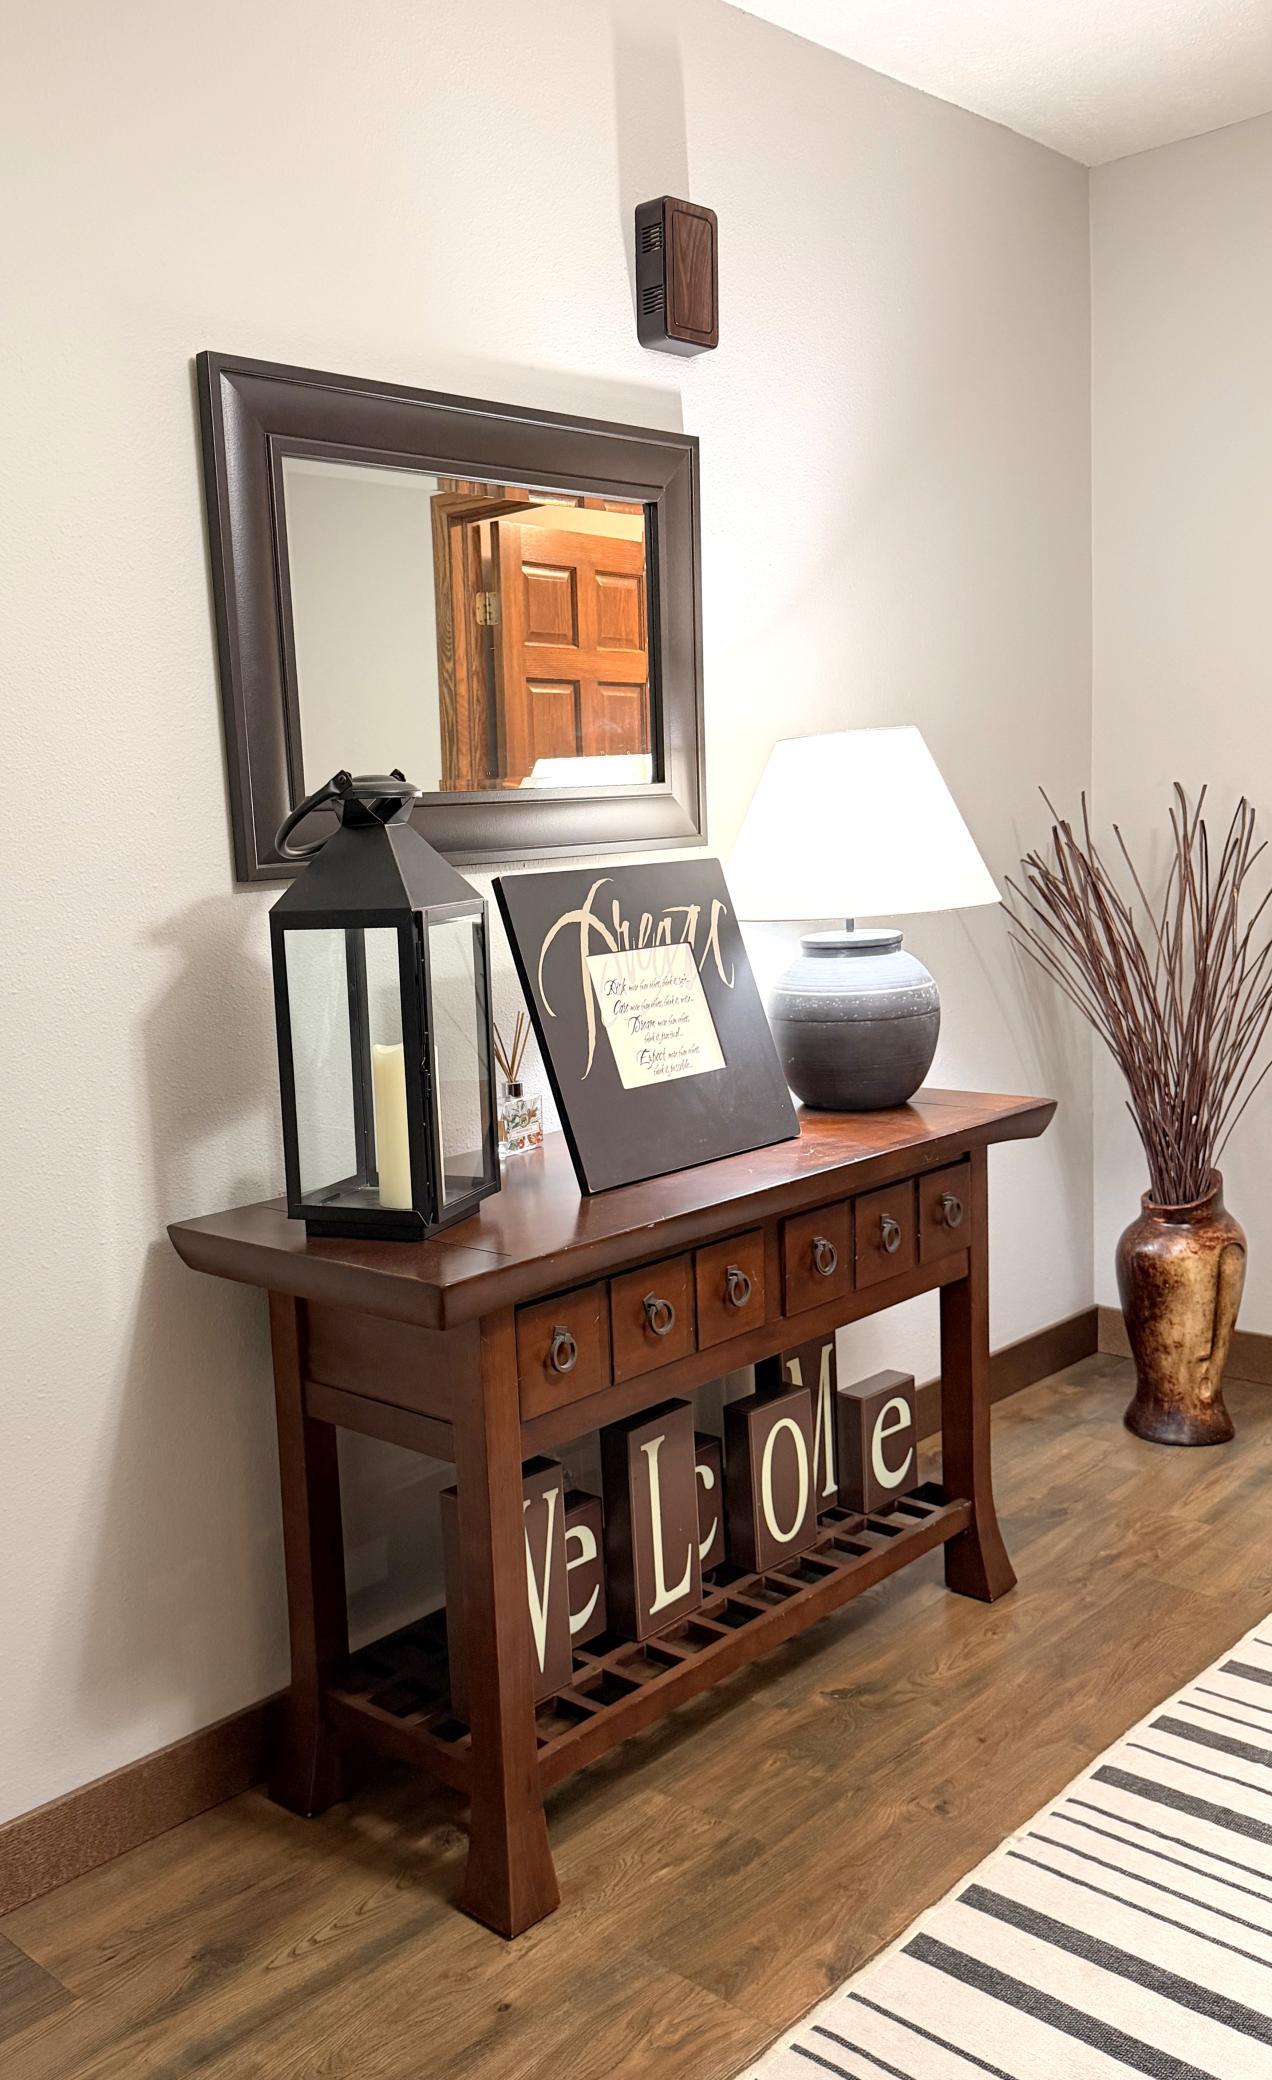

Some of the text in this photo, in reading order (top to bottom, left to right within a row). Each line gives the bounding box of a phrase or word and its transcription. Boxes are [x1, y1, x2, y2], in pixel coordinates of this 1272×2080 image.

[604, 977, 626, 996] Risk
[628, 1014, 656, 1036] Dream
[636, 1048, 666, 1070] Expect
